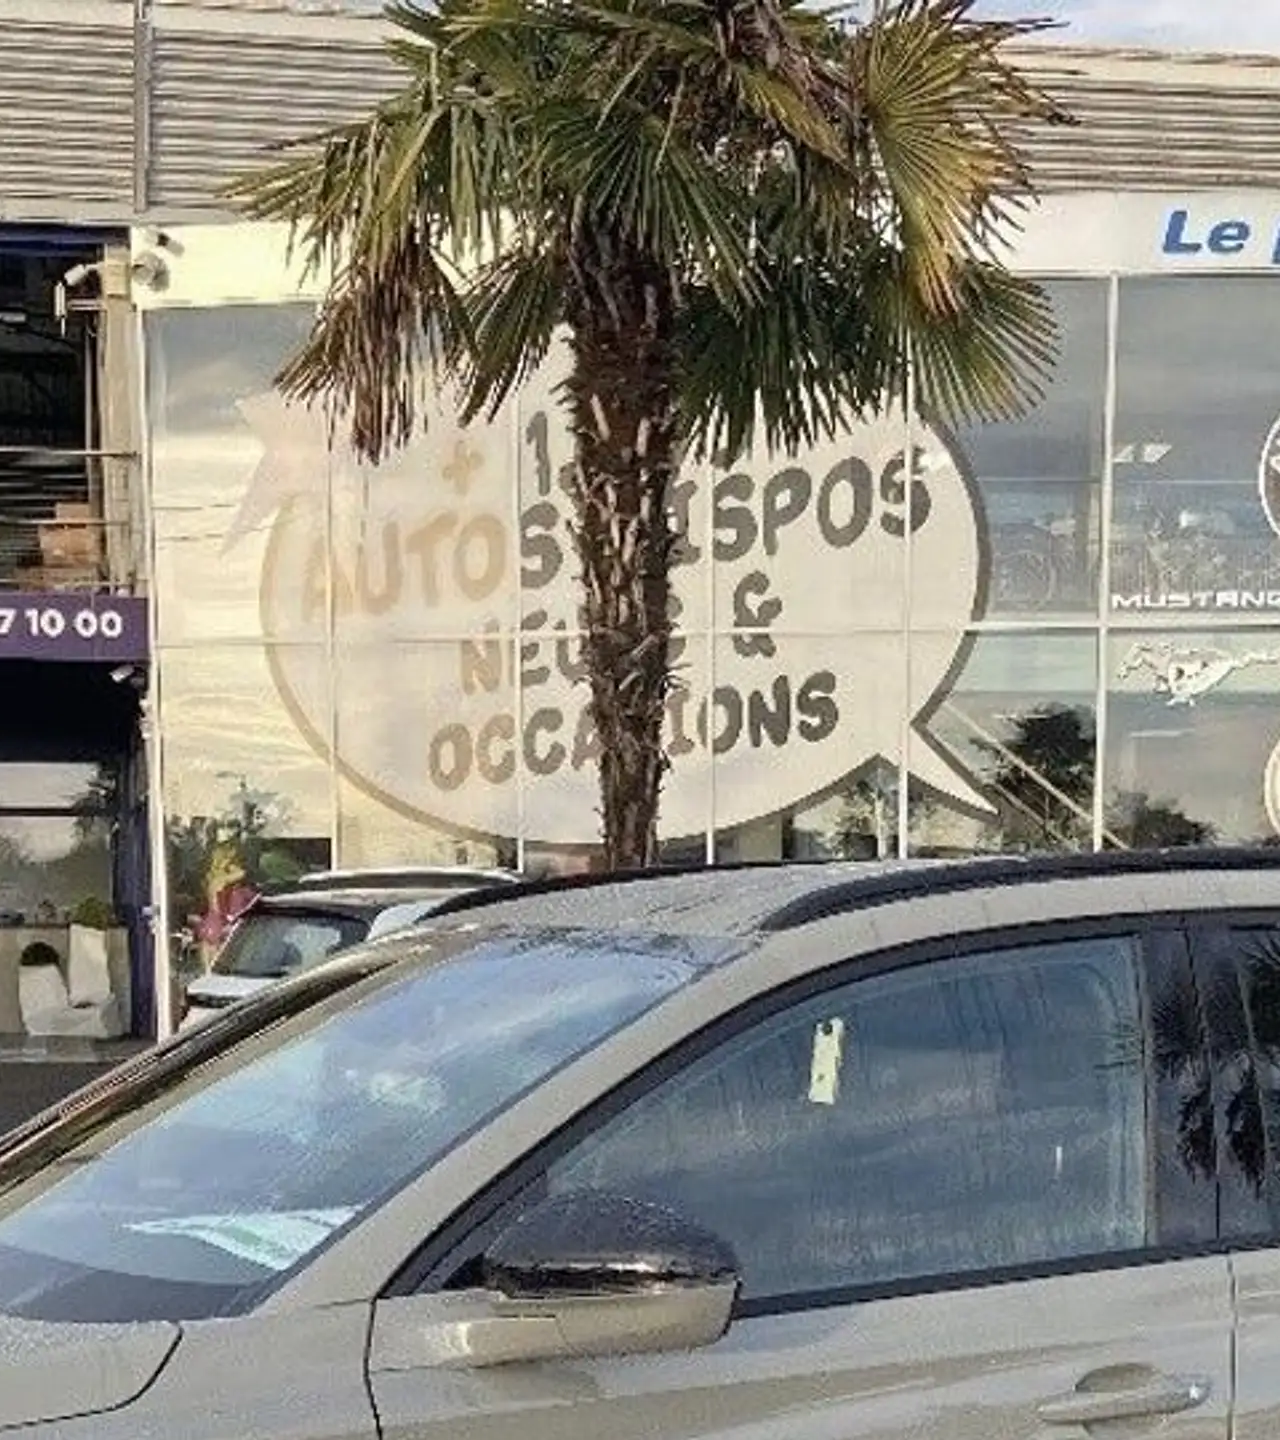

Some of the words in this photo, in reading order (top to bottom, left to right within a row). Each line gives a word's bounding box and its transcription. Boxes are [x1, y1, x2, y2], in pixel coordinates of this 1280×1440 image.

[1162, 209, 1249, 254] Le
[299, 501, 564, 623] AUTOS
[662, 446, 931, 564] ISPOS
[24, 609, 65, 638] 10
[73, 610, 124, 639] 00
[733, 570, 783, 658] &
[428, 670, 840, 792] OCCAIONS
